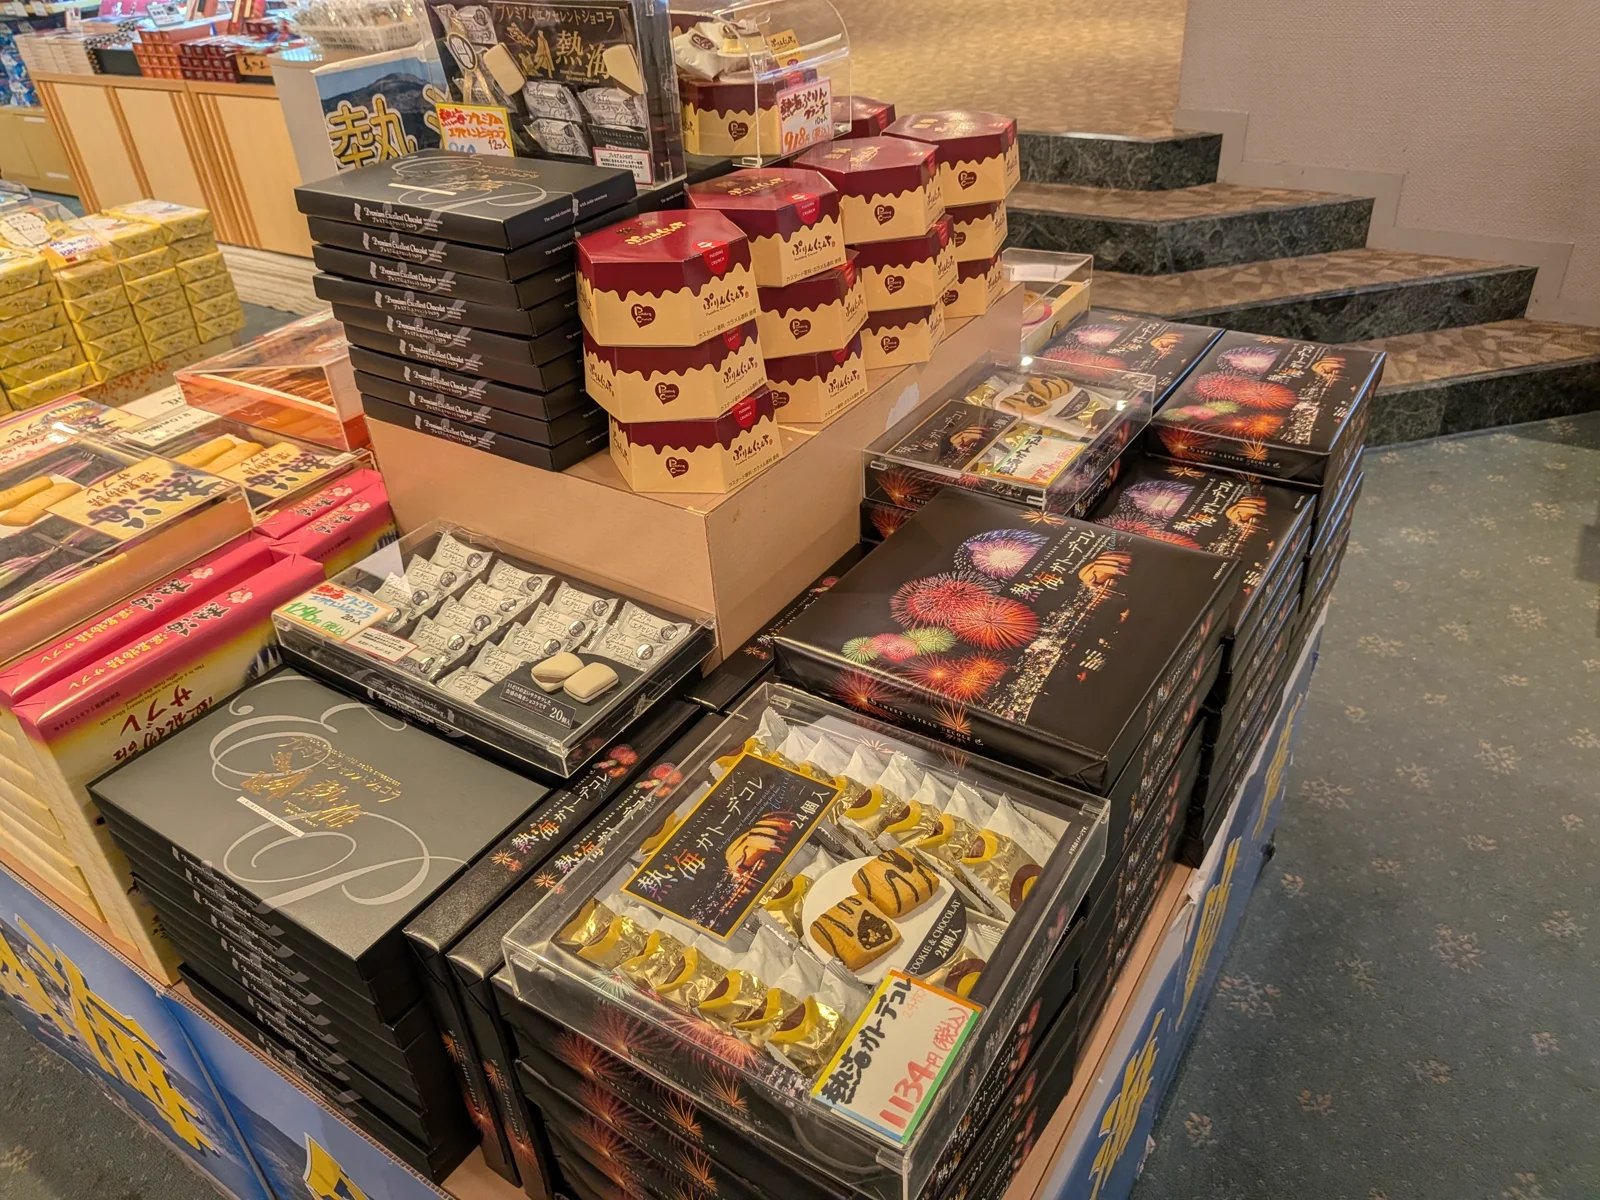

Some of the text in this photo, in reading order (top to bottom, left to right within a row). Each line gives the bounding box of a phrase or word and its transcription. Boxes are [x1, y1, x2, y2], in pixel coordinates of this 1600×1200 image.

[497, 4, 615, 32] プレミアムエクセレントショコラ
[779, 87, 828, 122] 熱海ぷりん
[804, 101, 829, 120] クランチ
[709, 249, 724, 259] PUDDING
[710, 257, 725, 267] CRUNCH
[633, 305, 653, 317] Pudding
[703, 285, 746, 311] ぷりんくらんち
[658, 384, 676, 395] Pudding
[668, 459, 686, 469] Pudding
[86, 472, 224, 528] 熱海
[1009, 529, 1096, 603] 熱海ガトーデコレ
[166, 603, 231, 637] 熱海
[40, 641, 75, 664] サブレ
[69, 667, 105, 690] サブレ
[119, 684, 194, 737] サブレ
[549, 705, 571, 727] 20個入
[511, 772, 608, 855] 熱海ガトーデコレ
[789, 790, 831, 831] 24個入
[637, 776, 763, 902] 熱海ガトーデコレ
[908, 946, 931, 975] COOKIE
[933, 898, 962, 940] CHOCOLAT
[934, 926, 963, 960] 24個入
[820, 977, 913, 1105] 熱海ガトーデコレ
[879, 1006, 970, 1129] 1134円(税込)
